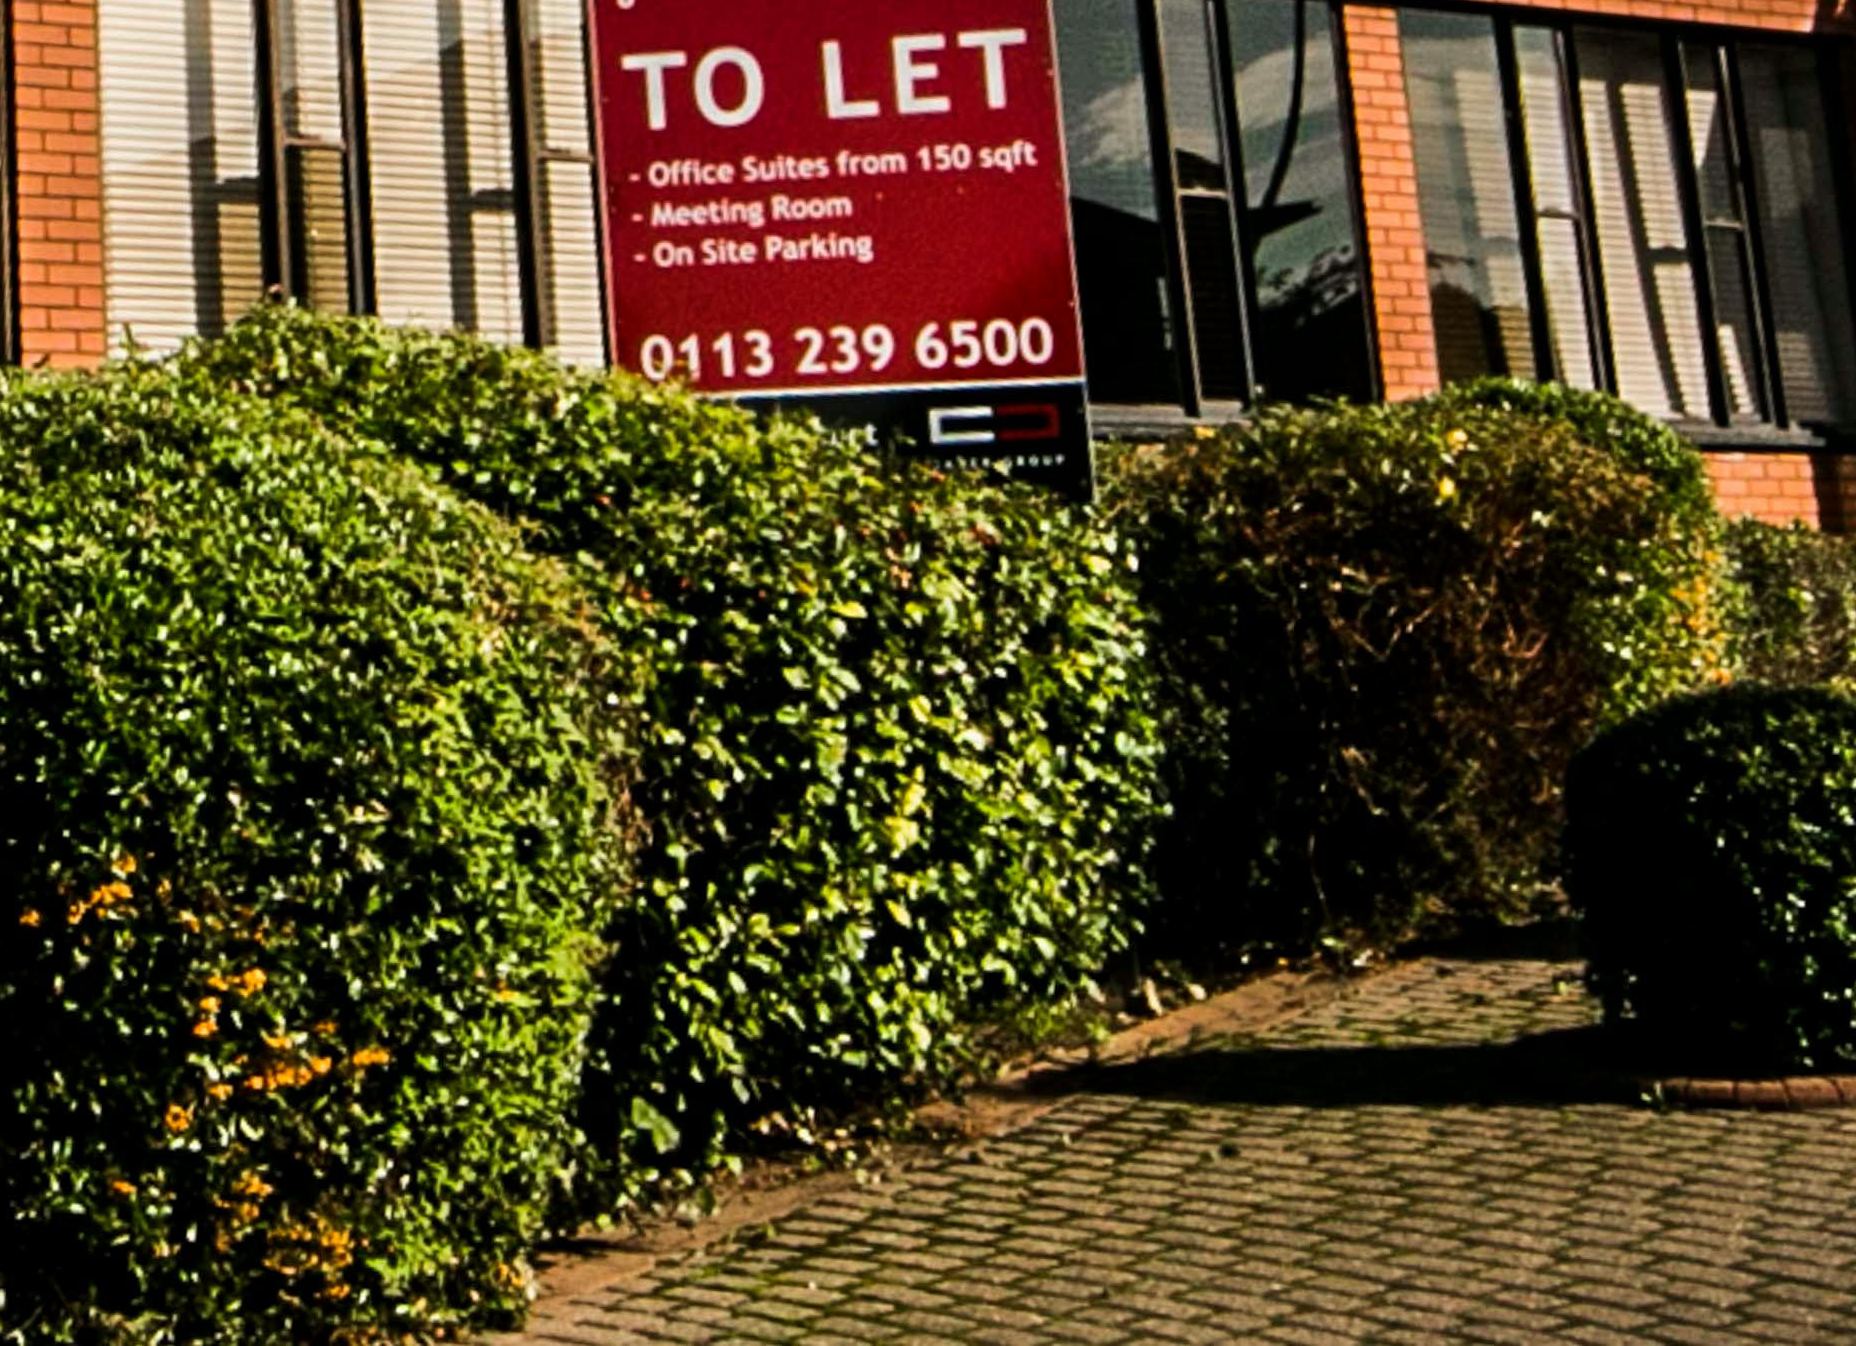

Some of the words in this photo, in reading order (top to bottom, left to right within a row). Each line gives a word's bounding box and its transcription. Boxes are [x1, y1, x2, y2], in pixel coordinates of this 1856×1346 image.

[621, 45, 765, 131] TO
[822, 28, 1028, 120] LET
[648, 160, 735, 188] Office
[742, 155, 830, 182] Suites
[836, 149, 908, 175] from
[917, 142, 972, 171] 150
[979, 139, 1038, 173] sqft
[651, 197, 766, 229] Meeting
[771, 194, 853, 221] Room
[653, 240, 694, 268] On
[701, 237, 757, 266] Site
[764, 231, 874, 263] Parking
[640, 329, 775, 382] 0113
[794, 323, 896, 375] 239
[915, 317, 1055, 370] 6500
